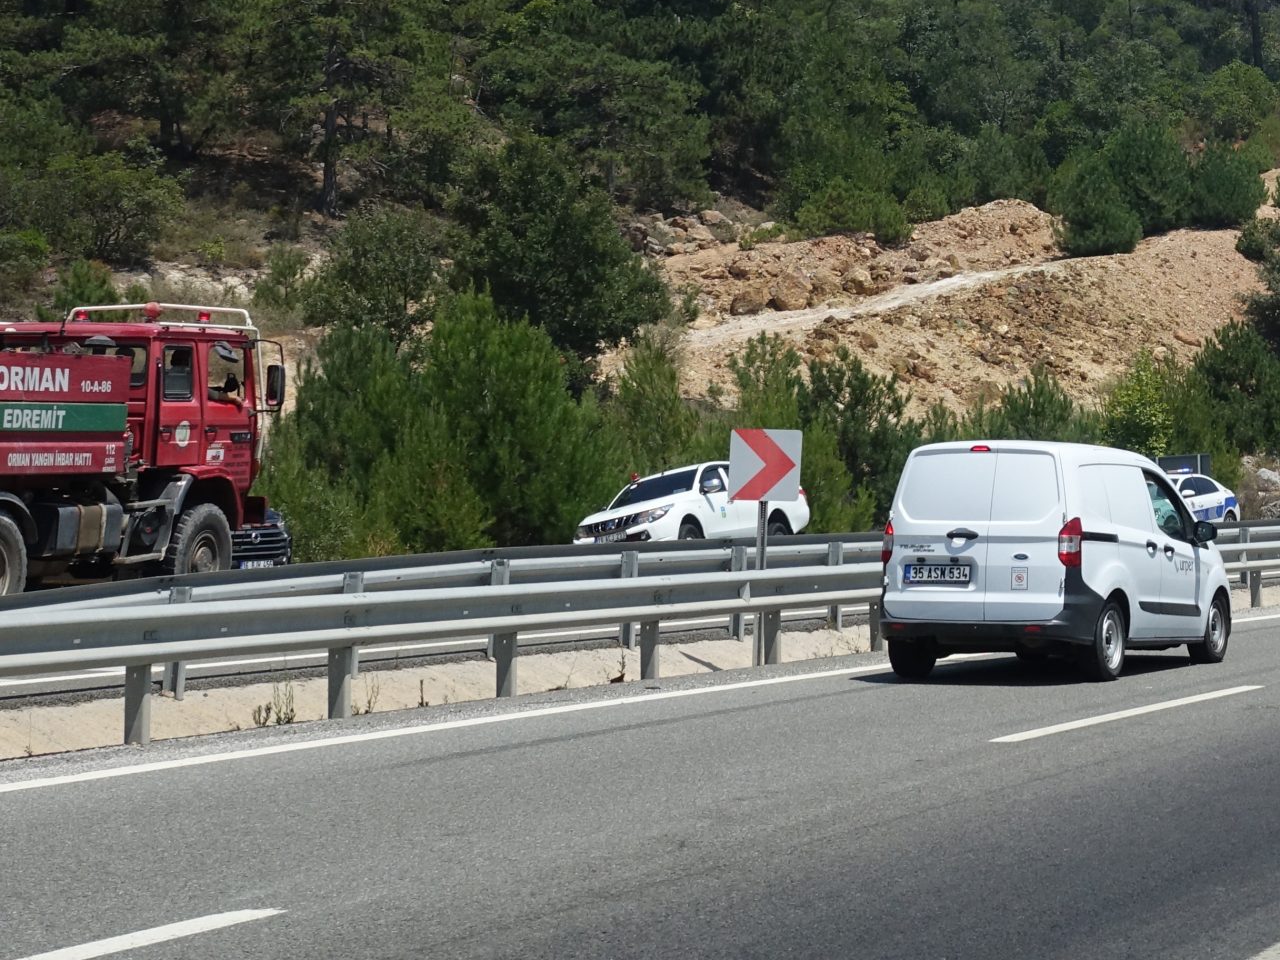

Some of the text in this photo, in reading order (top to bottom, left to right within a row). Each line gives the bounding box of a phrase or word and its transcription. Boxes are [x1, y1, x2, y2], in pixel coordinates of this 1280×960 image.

[0, 366, 70, 392] ORMAN
[81, 380, 112, 393] 10-A-86
[3, 405, 66, 429] EDREMİT
[106, 444, 116, 455] 112
[8, 449, 92, 467] ORMAN YANGIN İHBAR HATTI
[912, 567, 968, 579] 35 ASN 534
